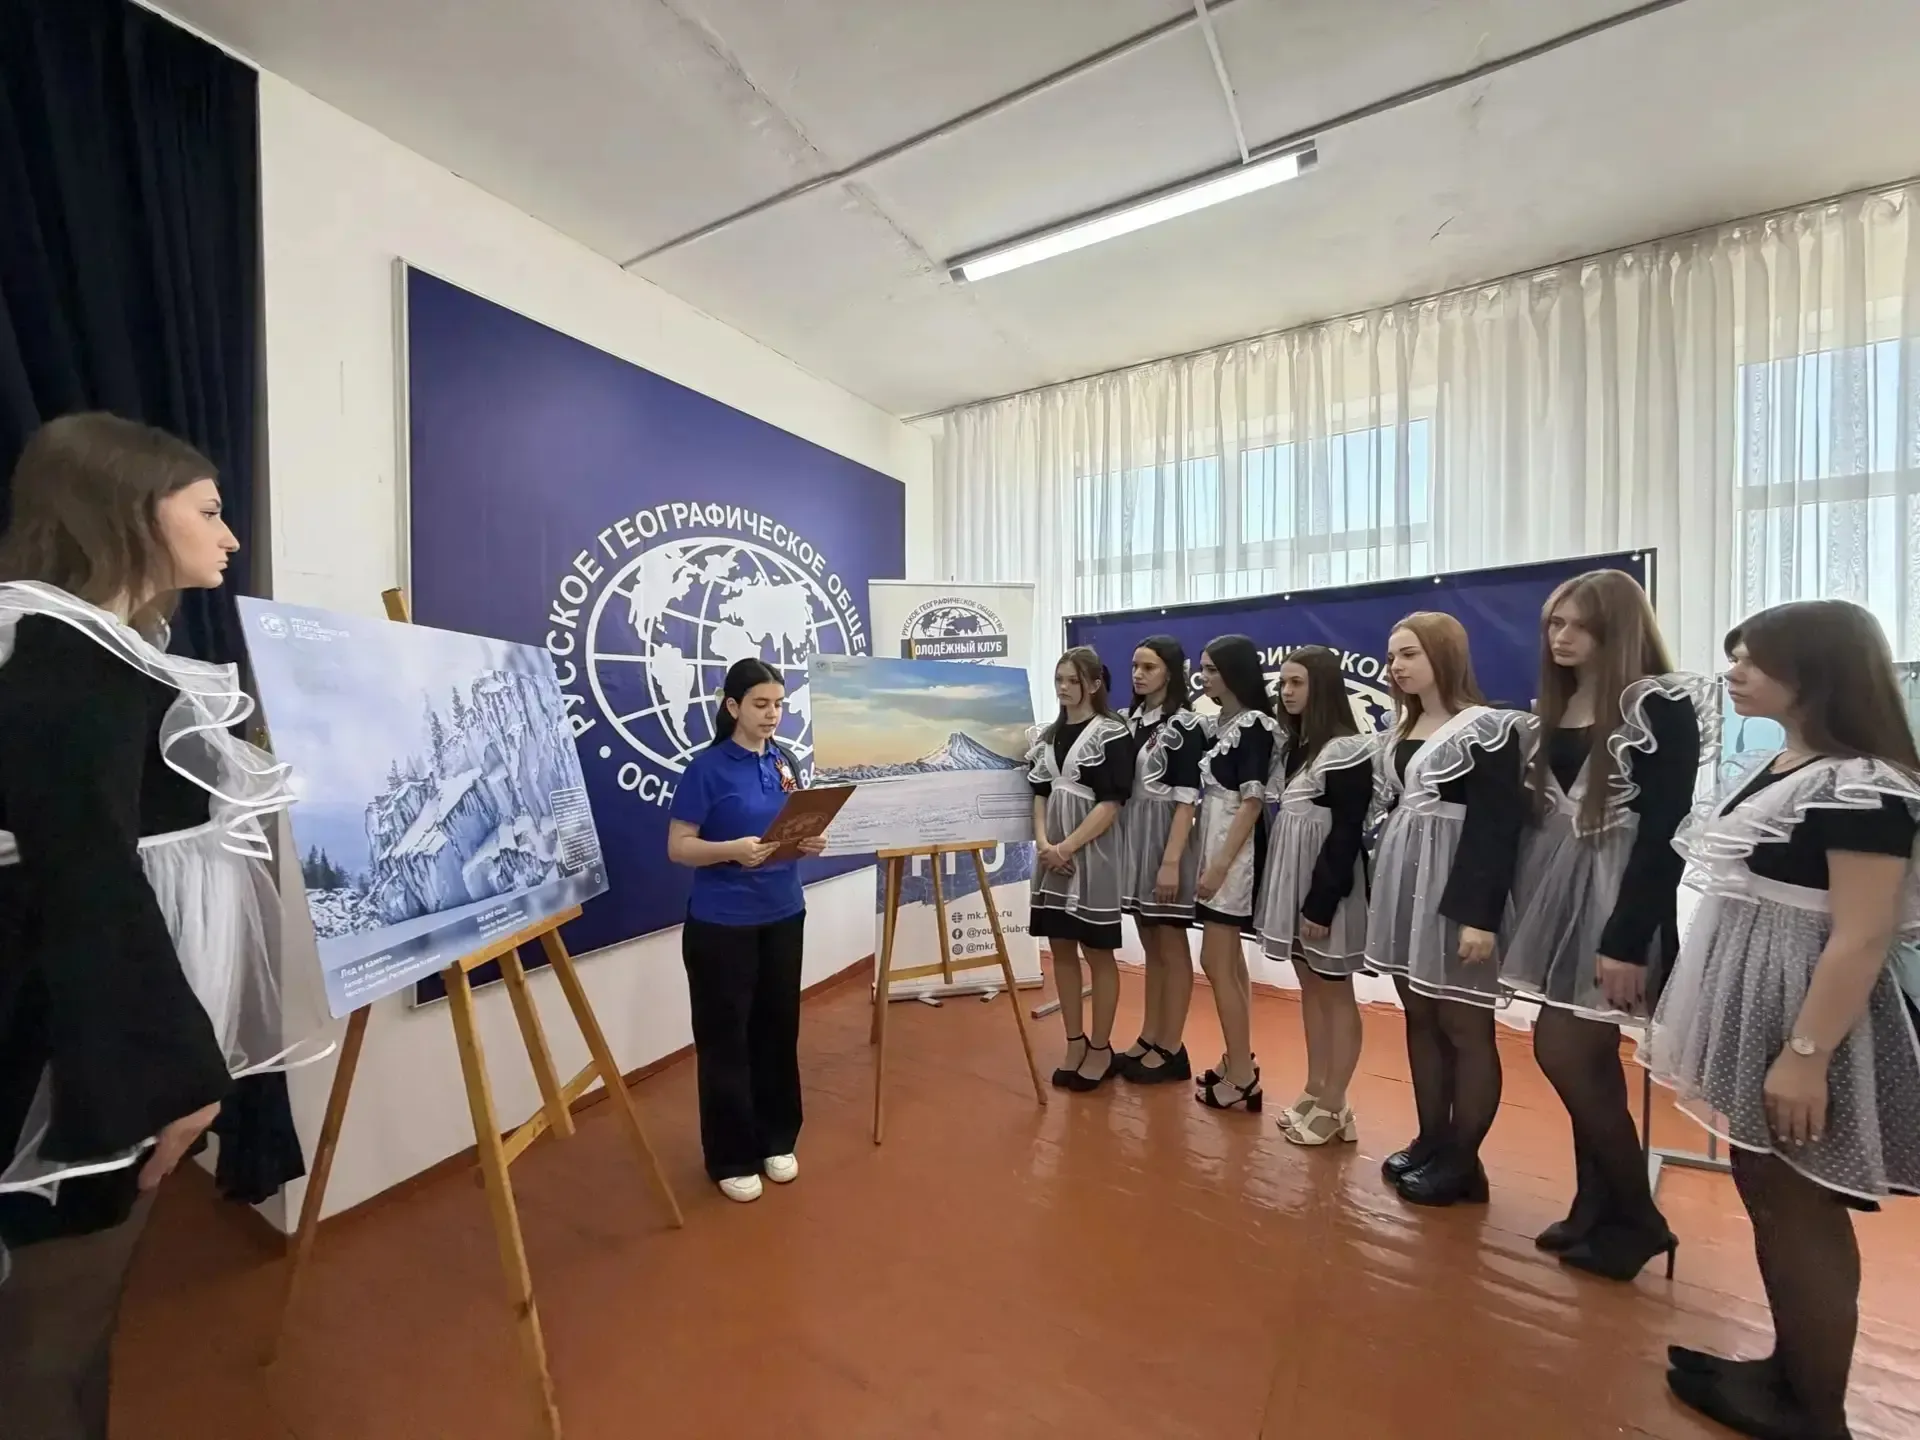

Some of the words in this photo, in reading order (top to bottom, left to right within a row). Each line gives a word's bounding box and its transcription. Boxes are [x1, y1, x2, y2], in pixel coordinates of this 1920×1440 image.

[546, 550, 604, 738] РУССКОЕ
[597, 502, 826, 576] ГЕОГРАФИЧЕСКОЕ
[827, 573, 868, 656] ОБЩЕ
[902, 606, 920, 636] РУССКОЕ
[918, 597, 977, 613] ГЕОГРАФИЧЕСКОЕ
[976, 604, 1004, 632] ОБЩЕСТВО
[915, 641, 976, 656] ОЛОДЁЖНЫЙ
[977, 641, 1003, 653] КЛУБ
[967, 910, 1012, 920] mk.r.ru
[966, 941, 995, 954] @mkr
